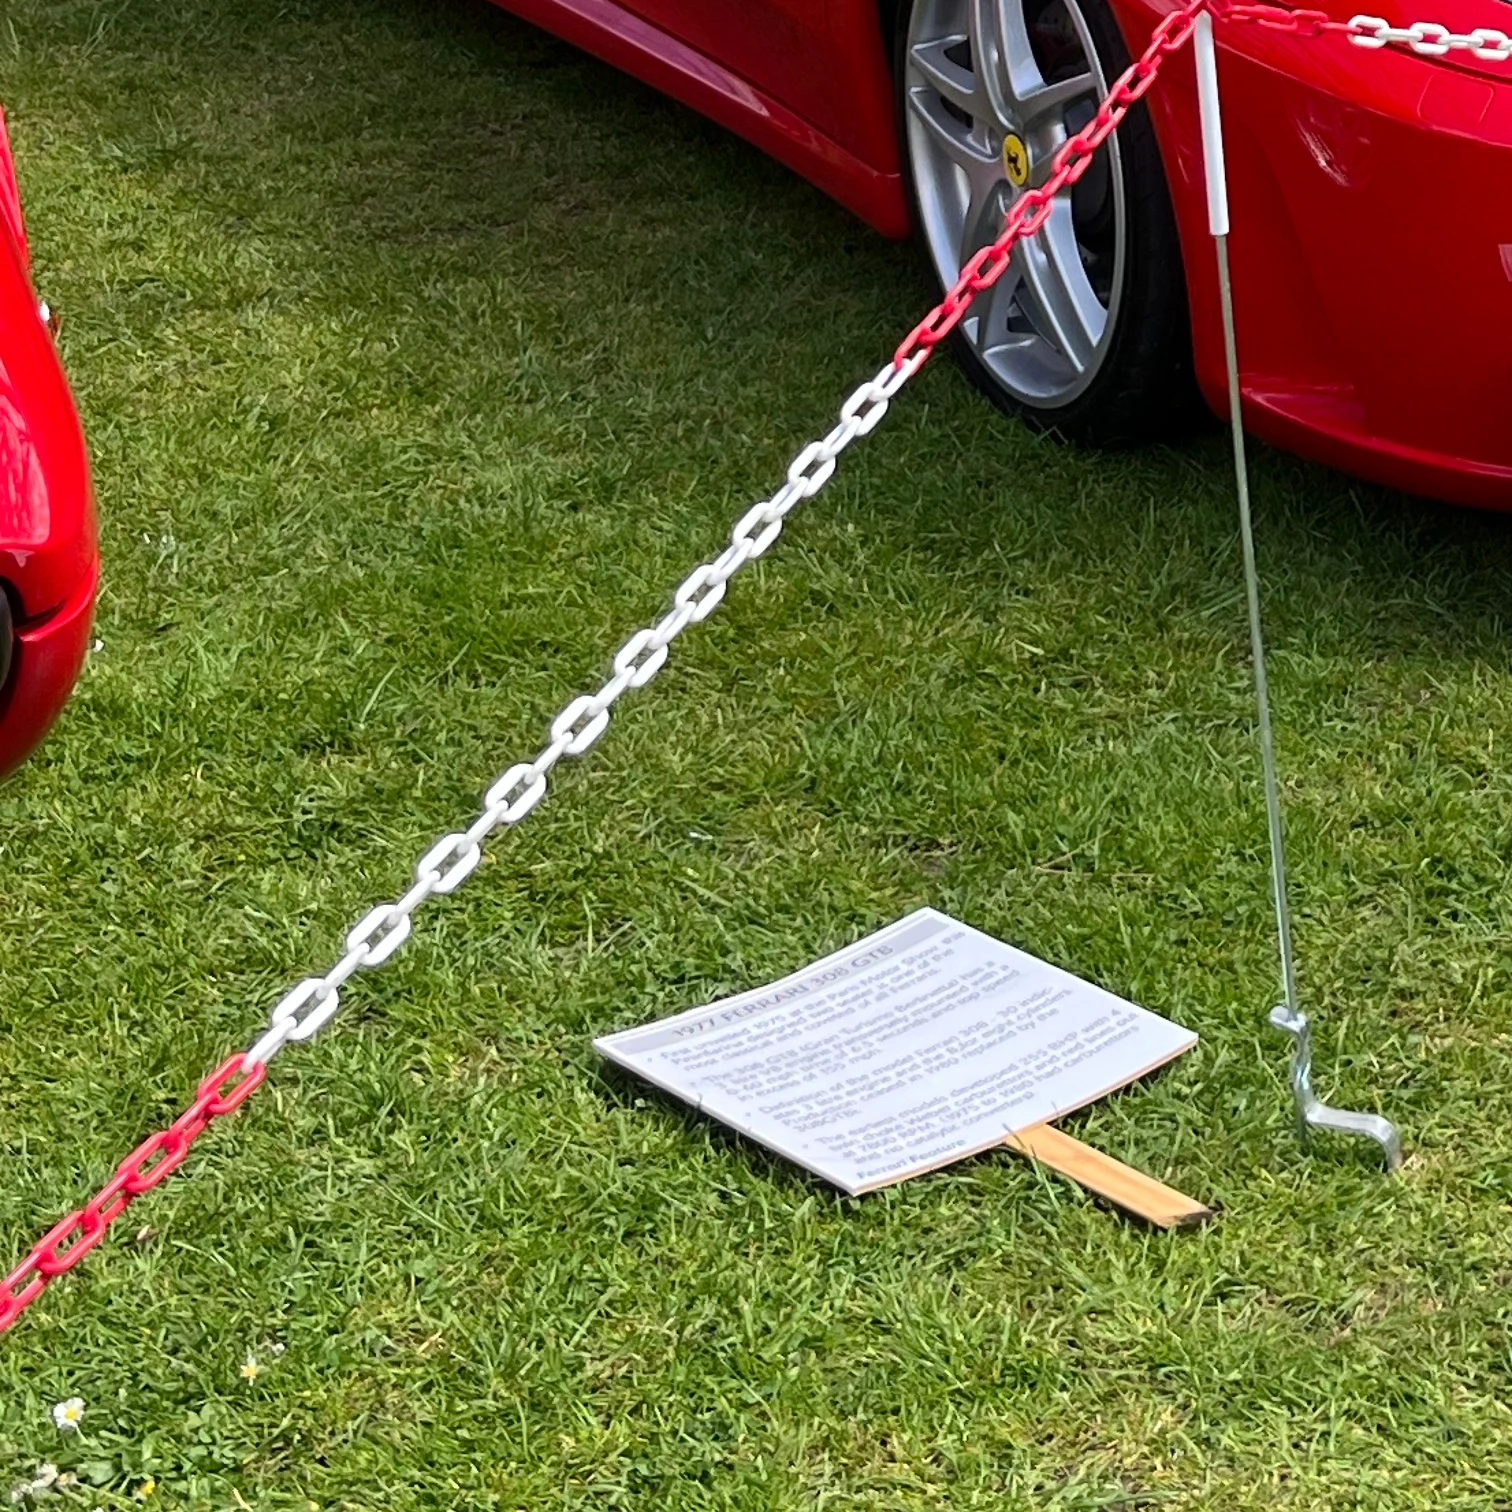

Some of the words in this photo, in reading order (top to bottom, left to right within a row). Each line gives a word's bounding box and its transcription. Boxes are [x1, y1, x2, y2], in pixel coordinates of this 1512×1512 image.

[671, 1017, 718, 1037] 1977
[720, 983, 807, 1020] FERRARI
[810, 966, 848, 986] 308
[850, 944, 893, 968] GTB
[767, 1049, 796, 1064] GTB
[856, 1158, 907, 1178] Ferrari
[909, 1138, 965, 1162] Feature
